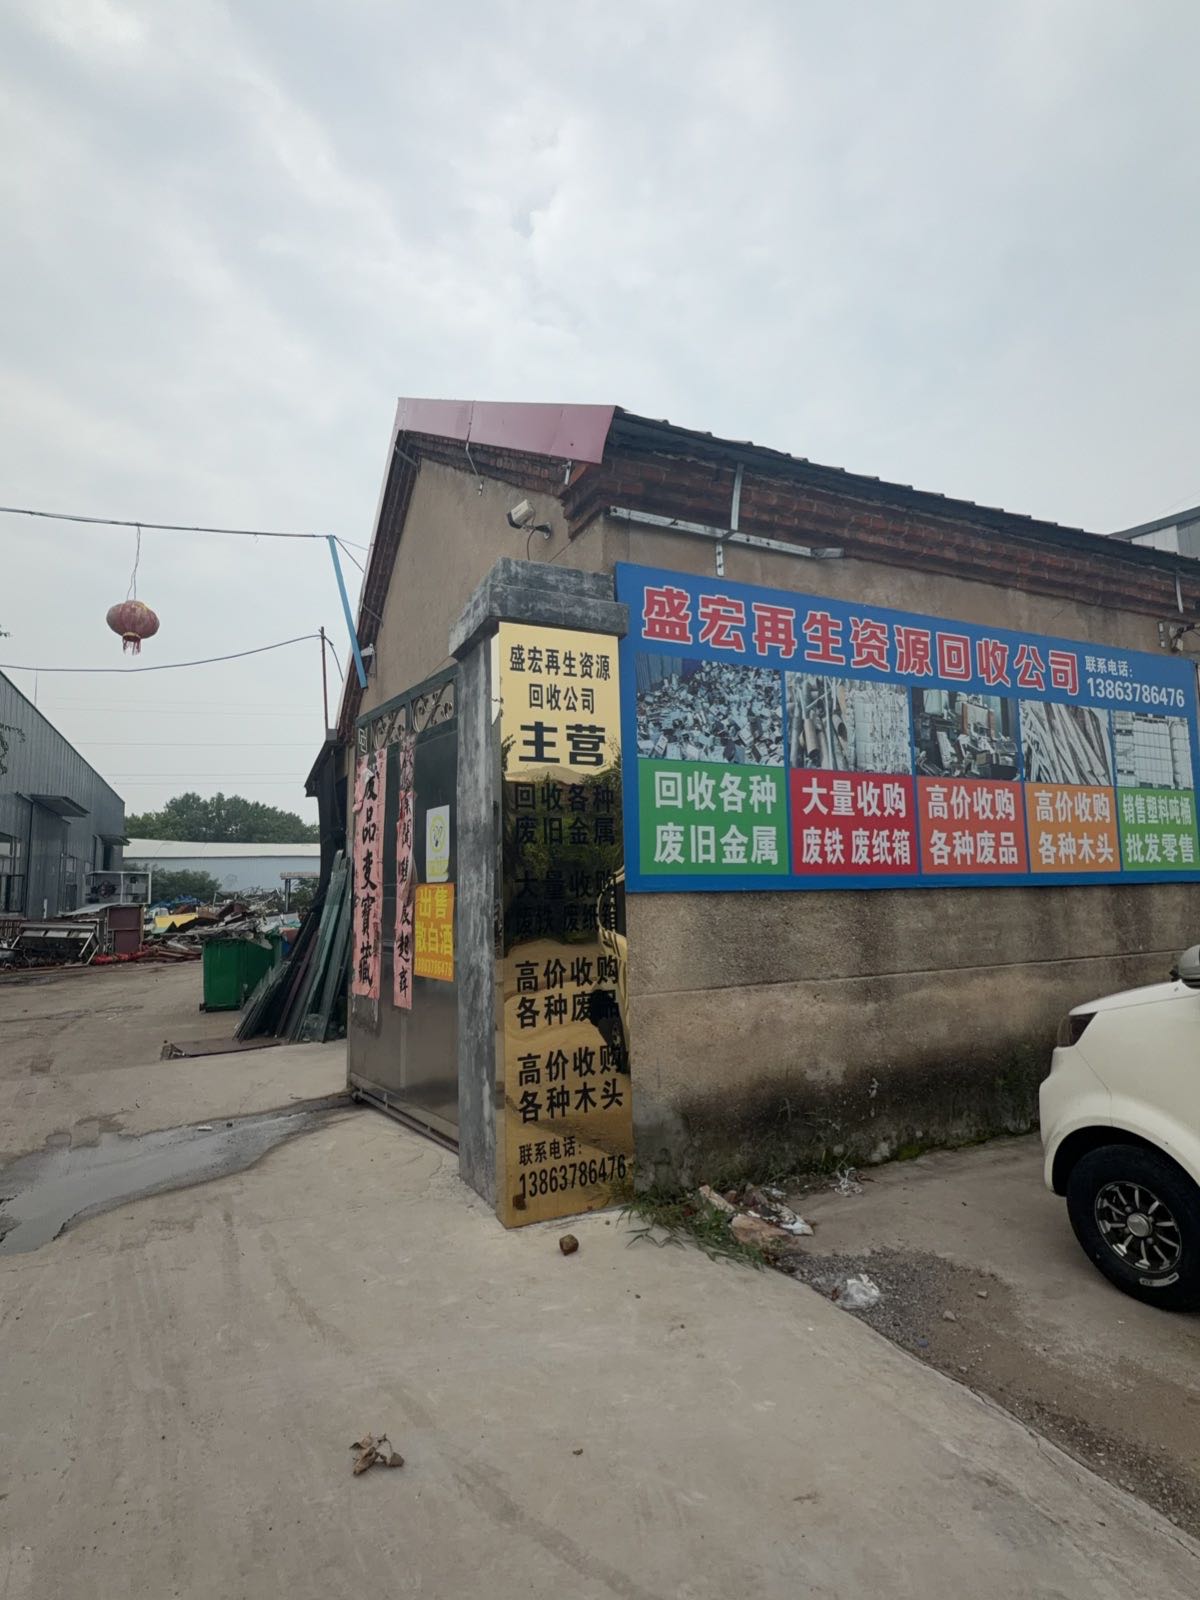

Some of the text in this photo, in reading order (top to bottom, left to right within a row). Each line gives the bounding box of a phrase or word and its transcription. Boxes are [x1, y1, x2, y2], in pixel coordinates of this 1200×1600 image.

[642, 585, 1080, 696] 盛宏再生资源回收公司
[509, 644, 611, 681] 盛宏再生资源
[528, 683, 595, 714] 回收公司
[1087, 677, 1185, 708] 13863786476
[518, 721, 605, 766] 主营
[514, 782, 615, 813] 回收各种
[654, 770, 777, 814] 回收各种
[802, 777, 906, 818] 大量收购
[926, 784, 1016, 822] 高价收购
[1034, 789, 1111, 823] 高价收购
[515, 815, 615, 845] 废旧金属
[654, 822, 778, 866] 废旧金属
[802, 827, 911, 865] 废铁 废纸箱
[930, 829, 1018, 865] 各种废品
[1038, 831, 1114, 865] 各种木头
[1125, 833, 1194, 863] 批发零售
[515, 955, 618, 992] 高价收购
[517, 1045, 621, 1086] 高价收购
[518, 1078, 623, 1124] 各种木头
[518, 1154, 626, 1200] 13863786476
